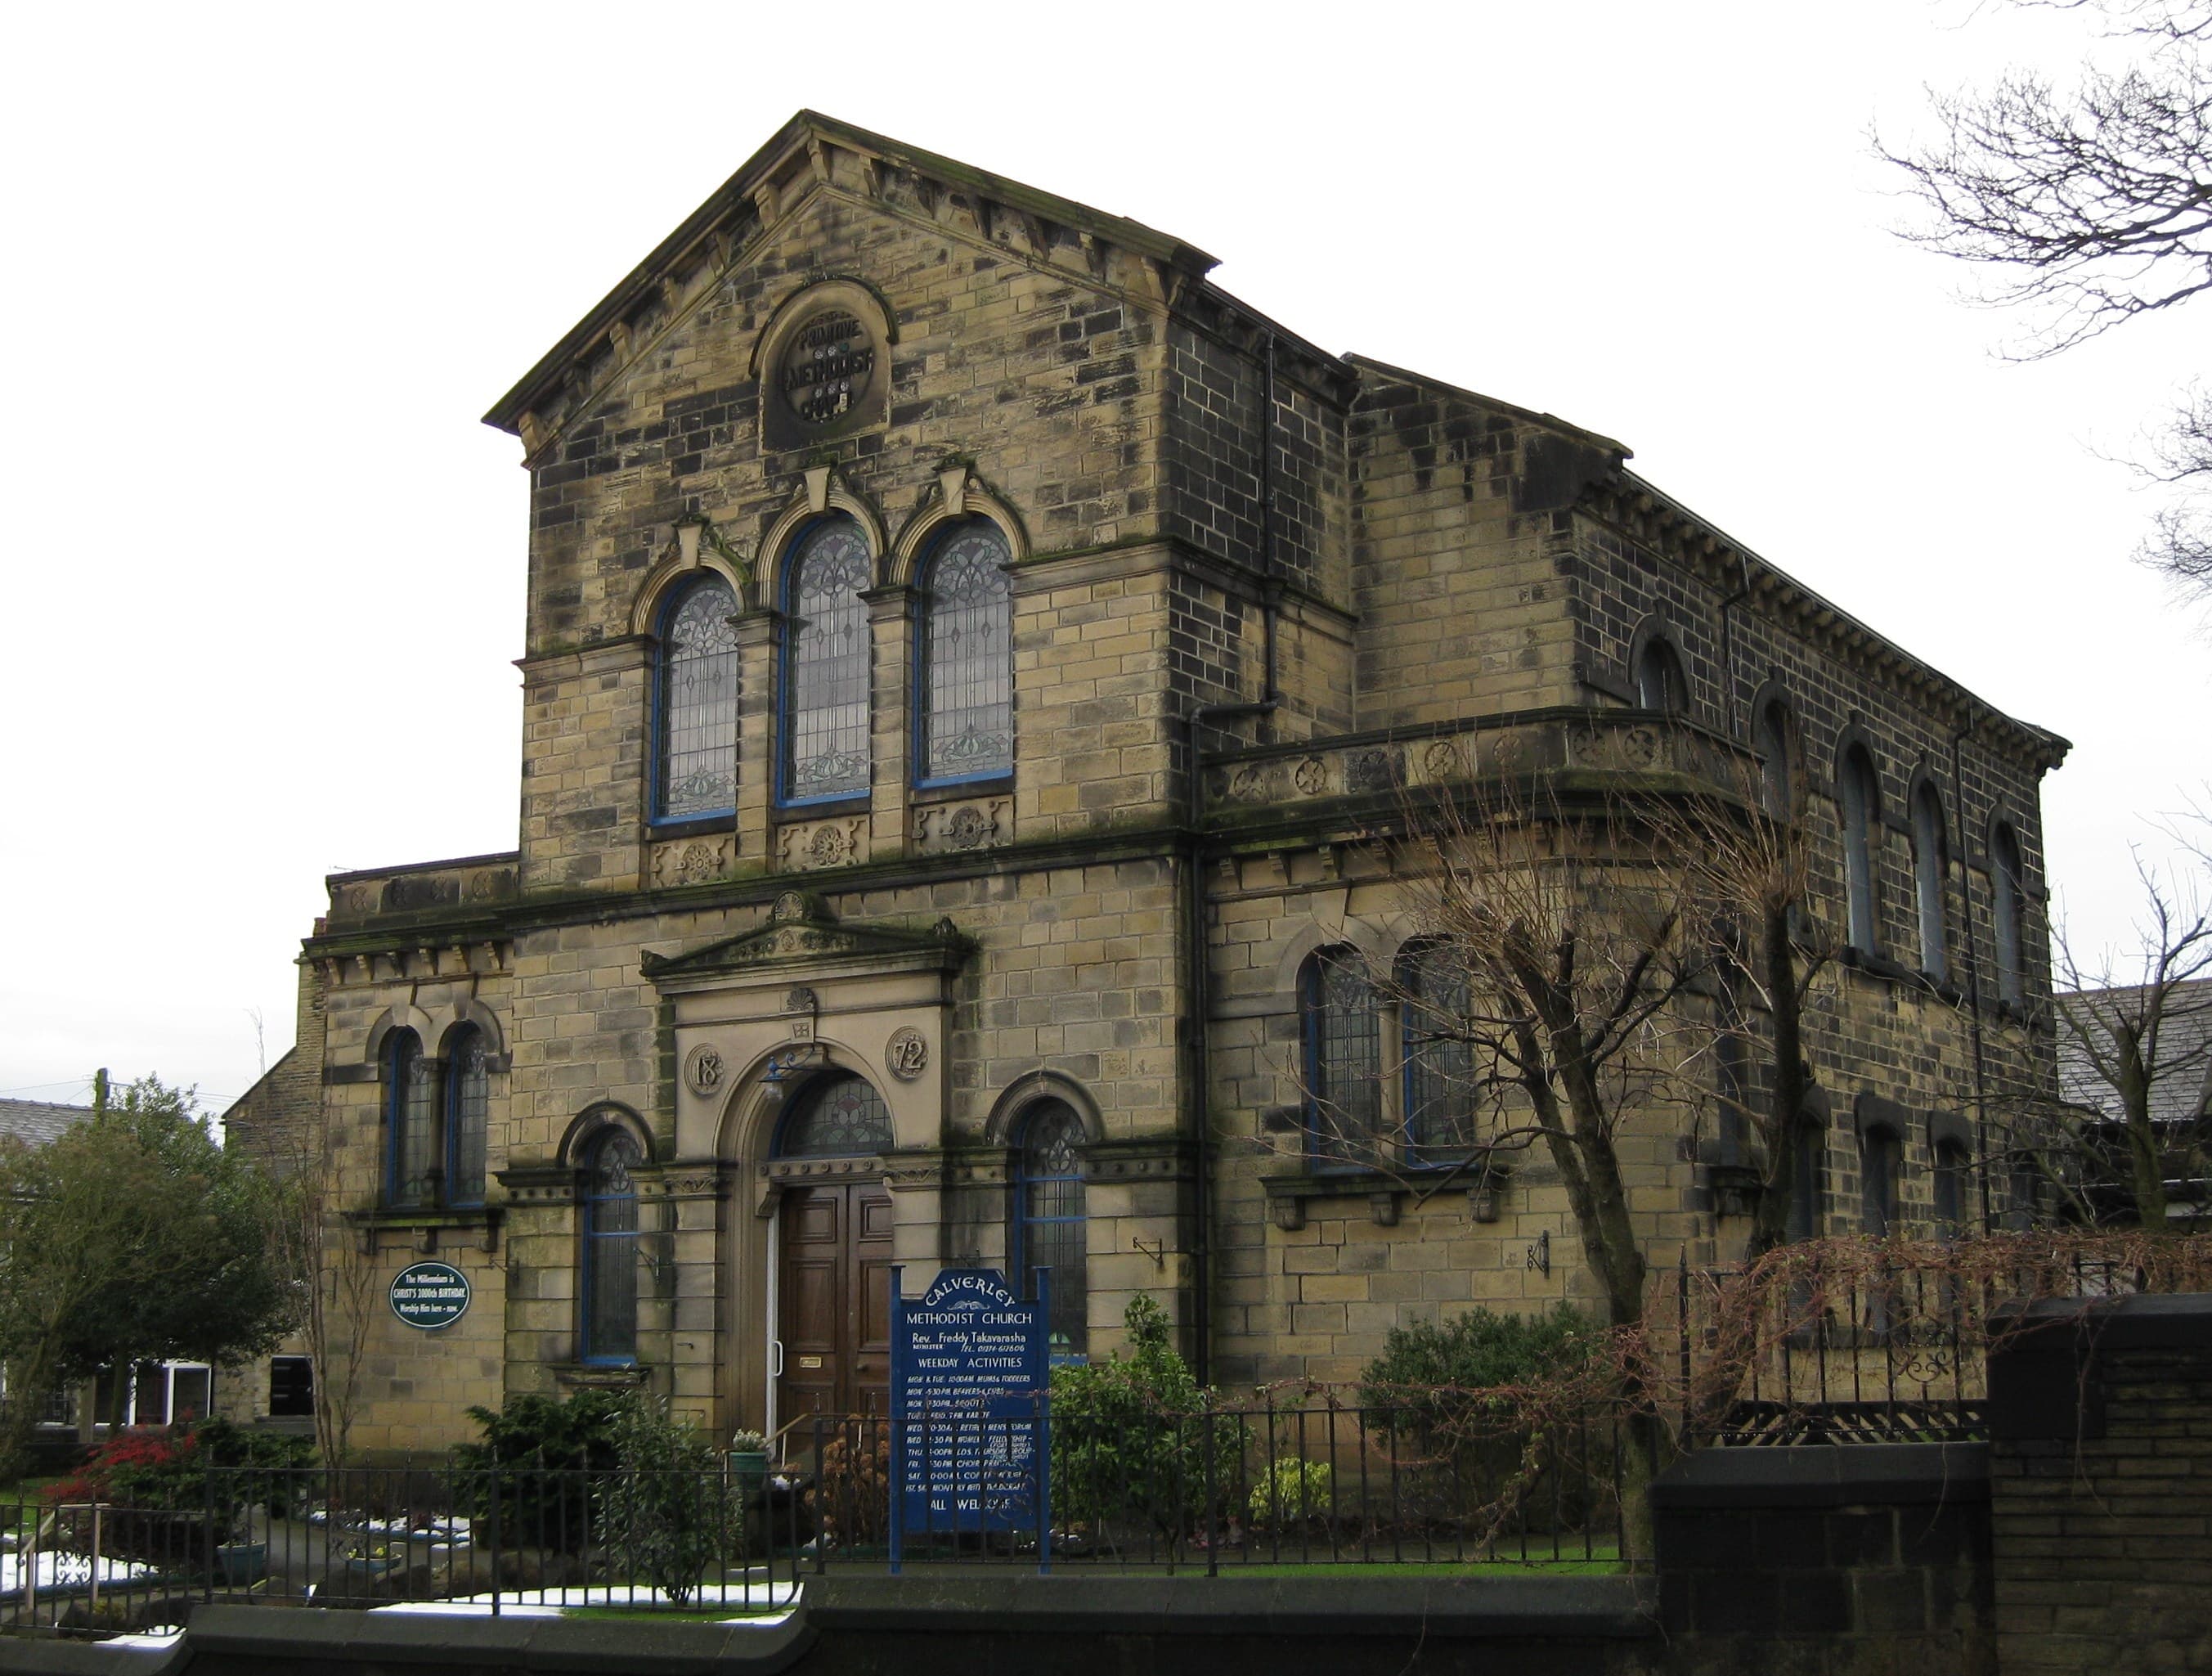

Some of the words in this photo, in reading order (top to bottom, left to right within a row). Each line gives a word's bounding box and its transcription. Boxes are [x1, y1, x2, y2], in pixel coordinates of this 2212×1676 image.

[895, 1041, 924, 1070] 72
[696, 1053, 717, 1085] 18
[406, 1274, 416, 1283] The
[449, 1274, 455, 1283] is
[925, 1276, 1016, 1308] CALVERLEY
[400, 1303, 419, 1314] Worship
[420, 1303, 430, 1313] Him
[431, 1303, 442, 1312] here
[906, 1313, 975, 1324] METHODIST
[982, 1313, 1032, 1324] CHURCH
[912, 1332, 931, 1343] Rev.
[939, 1332, 969, 1347] Freddy
[972, 1332, 1025, 1343] Takavarasha
[918, 1358, 959, 1368] WEEKDAY
[967, 1357, 1022, 1368] ACTIVITIES
[966, 1411, 990, 1419] KARTE
[956, 1459, 980, 1468] CHOIR
[931, 1499, 947, 1511] ALL
[957, 1499, 1012, 1511] WELOME
